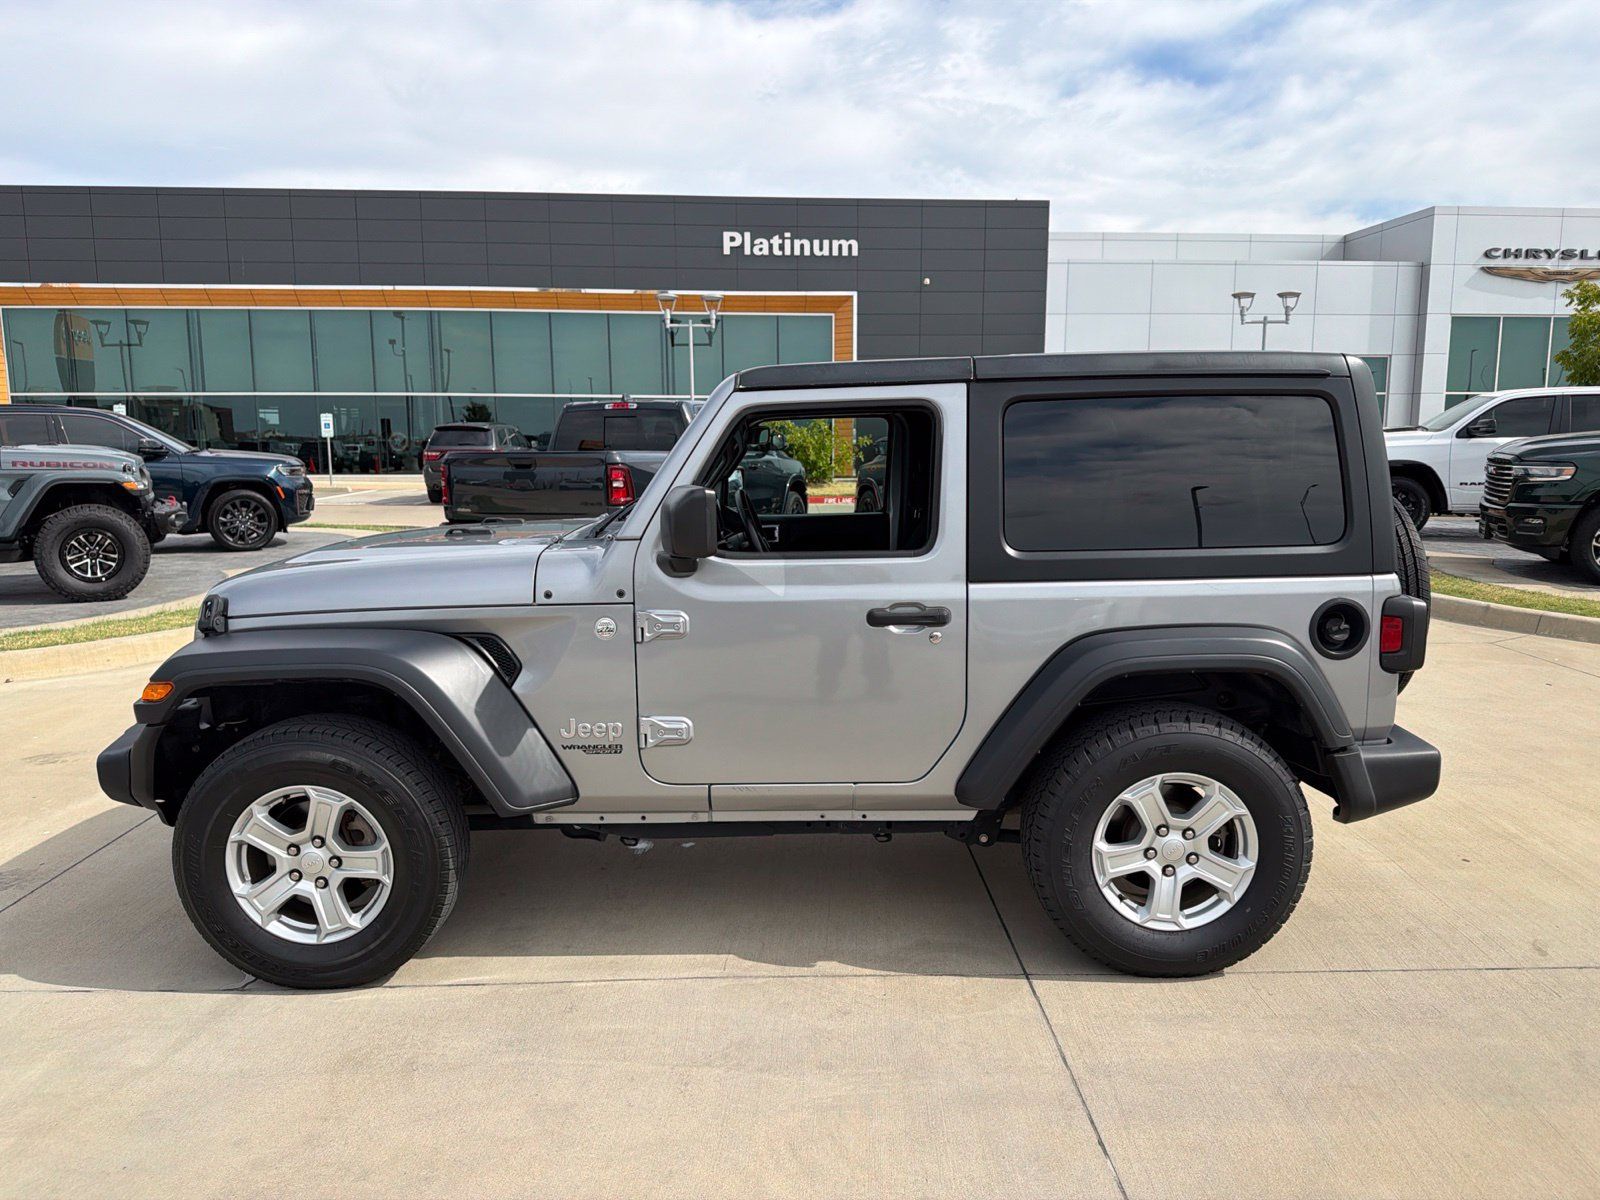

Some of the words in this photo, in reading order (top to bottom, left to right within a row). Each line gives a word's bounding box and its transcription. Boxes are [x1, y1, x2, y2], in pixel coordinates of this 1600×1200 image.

[723, 231, 859, 256] Platinum
[1483, 247, 1600, 260] CHRYSL
[11, 460, 116, 469] RUBICON
[560, 718, 622, 741] Jeep
